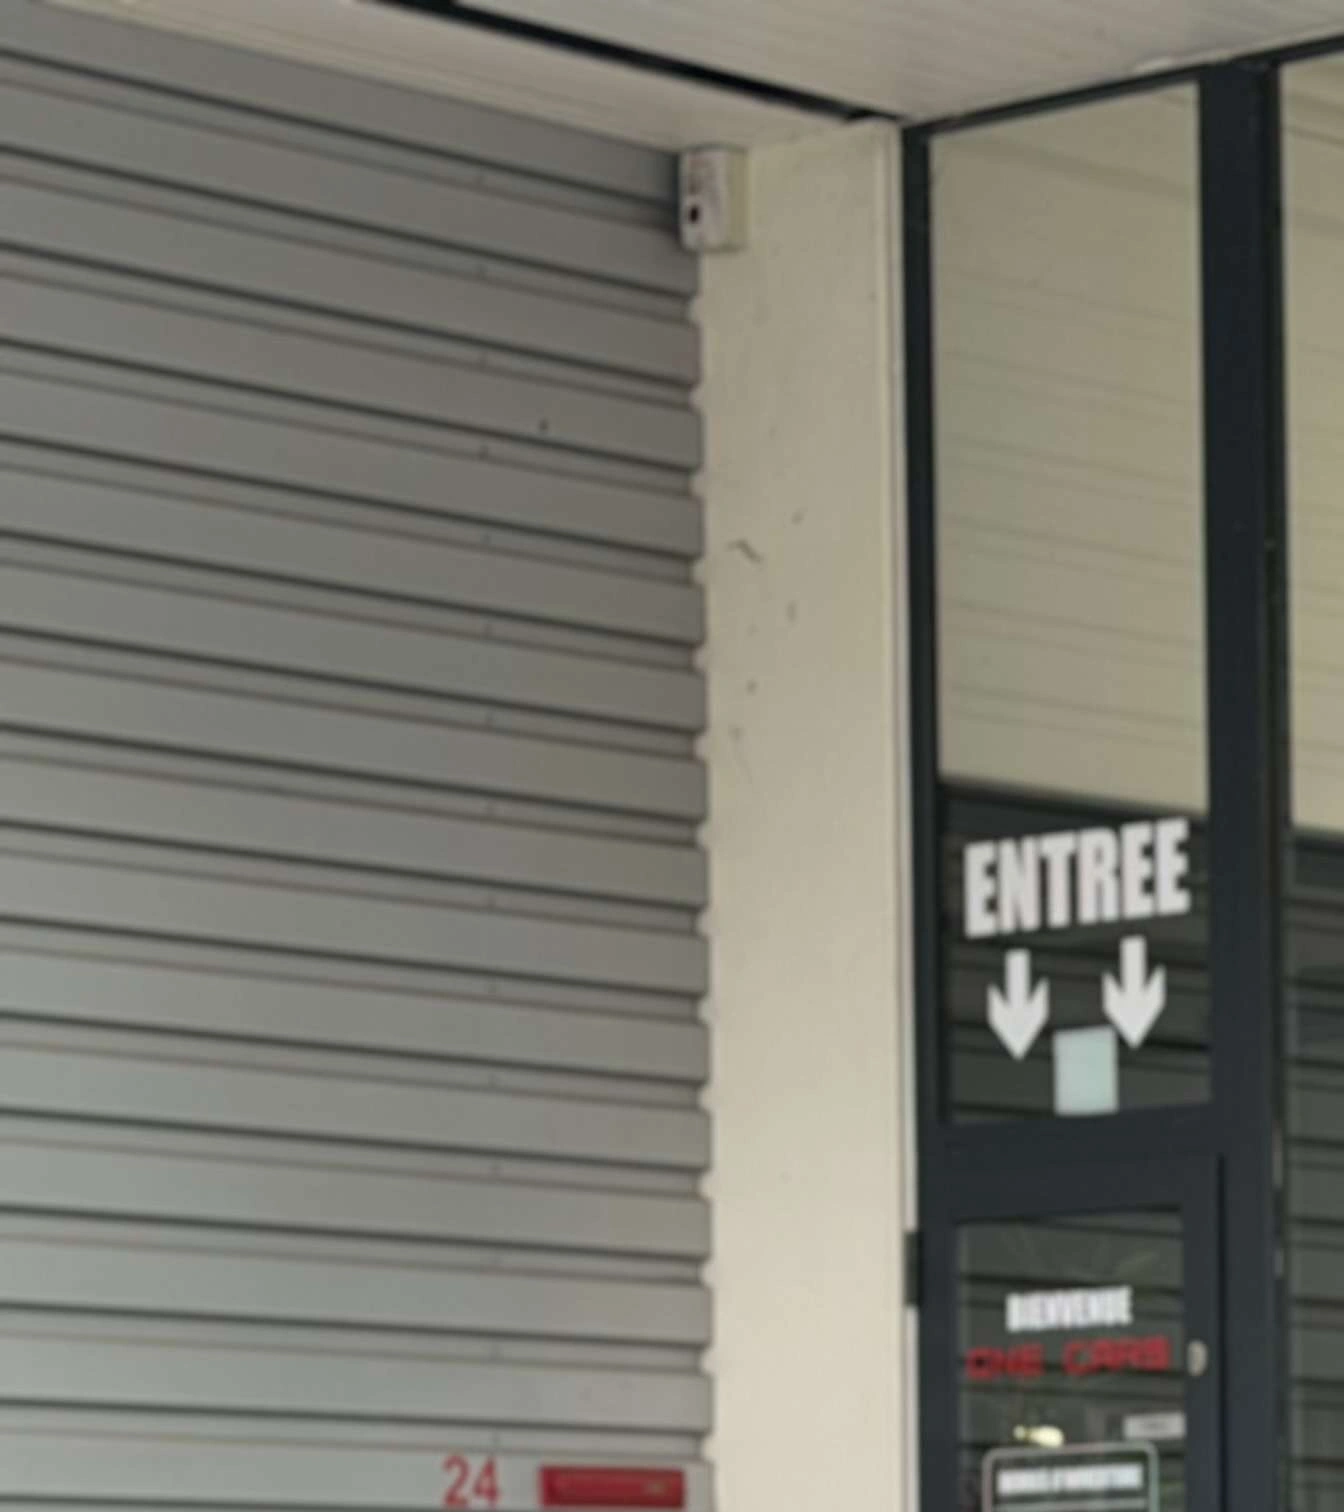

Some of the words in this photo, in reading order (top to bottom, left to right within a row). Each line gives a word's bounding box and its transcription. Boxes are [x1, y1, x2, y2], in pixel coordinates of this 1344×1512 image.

[962, 817, 1191, 939] ENTREE
[966, 1343, 1044, 1380] ONE
[1063, 1335, 1170, 1375] CARS
[441, 1455, 500, 1508] 24
